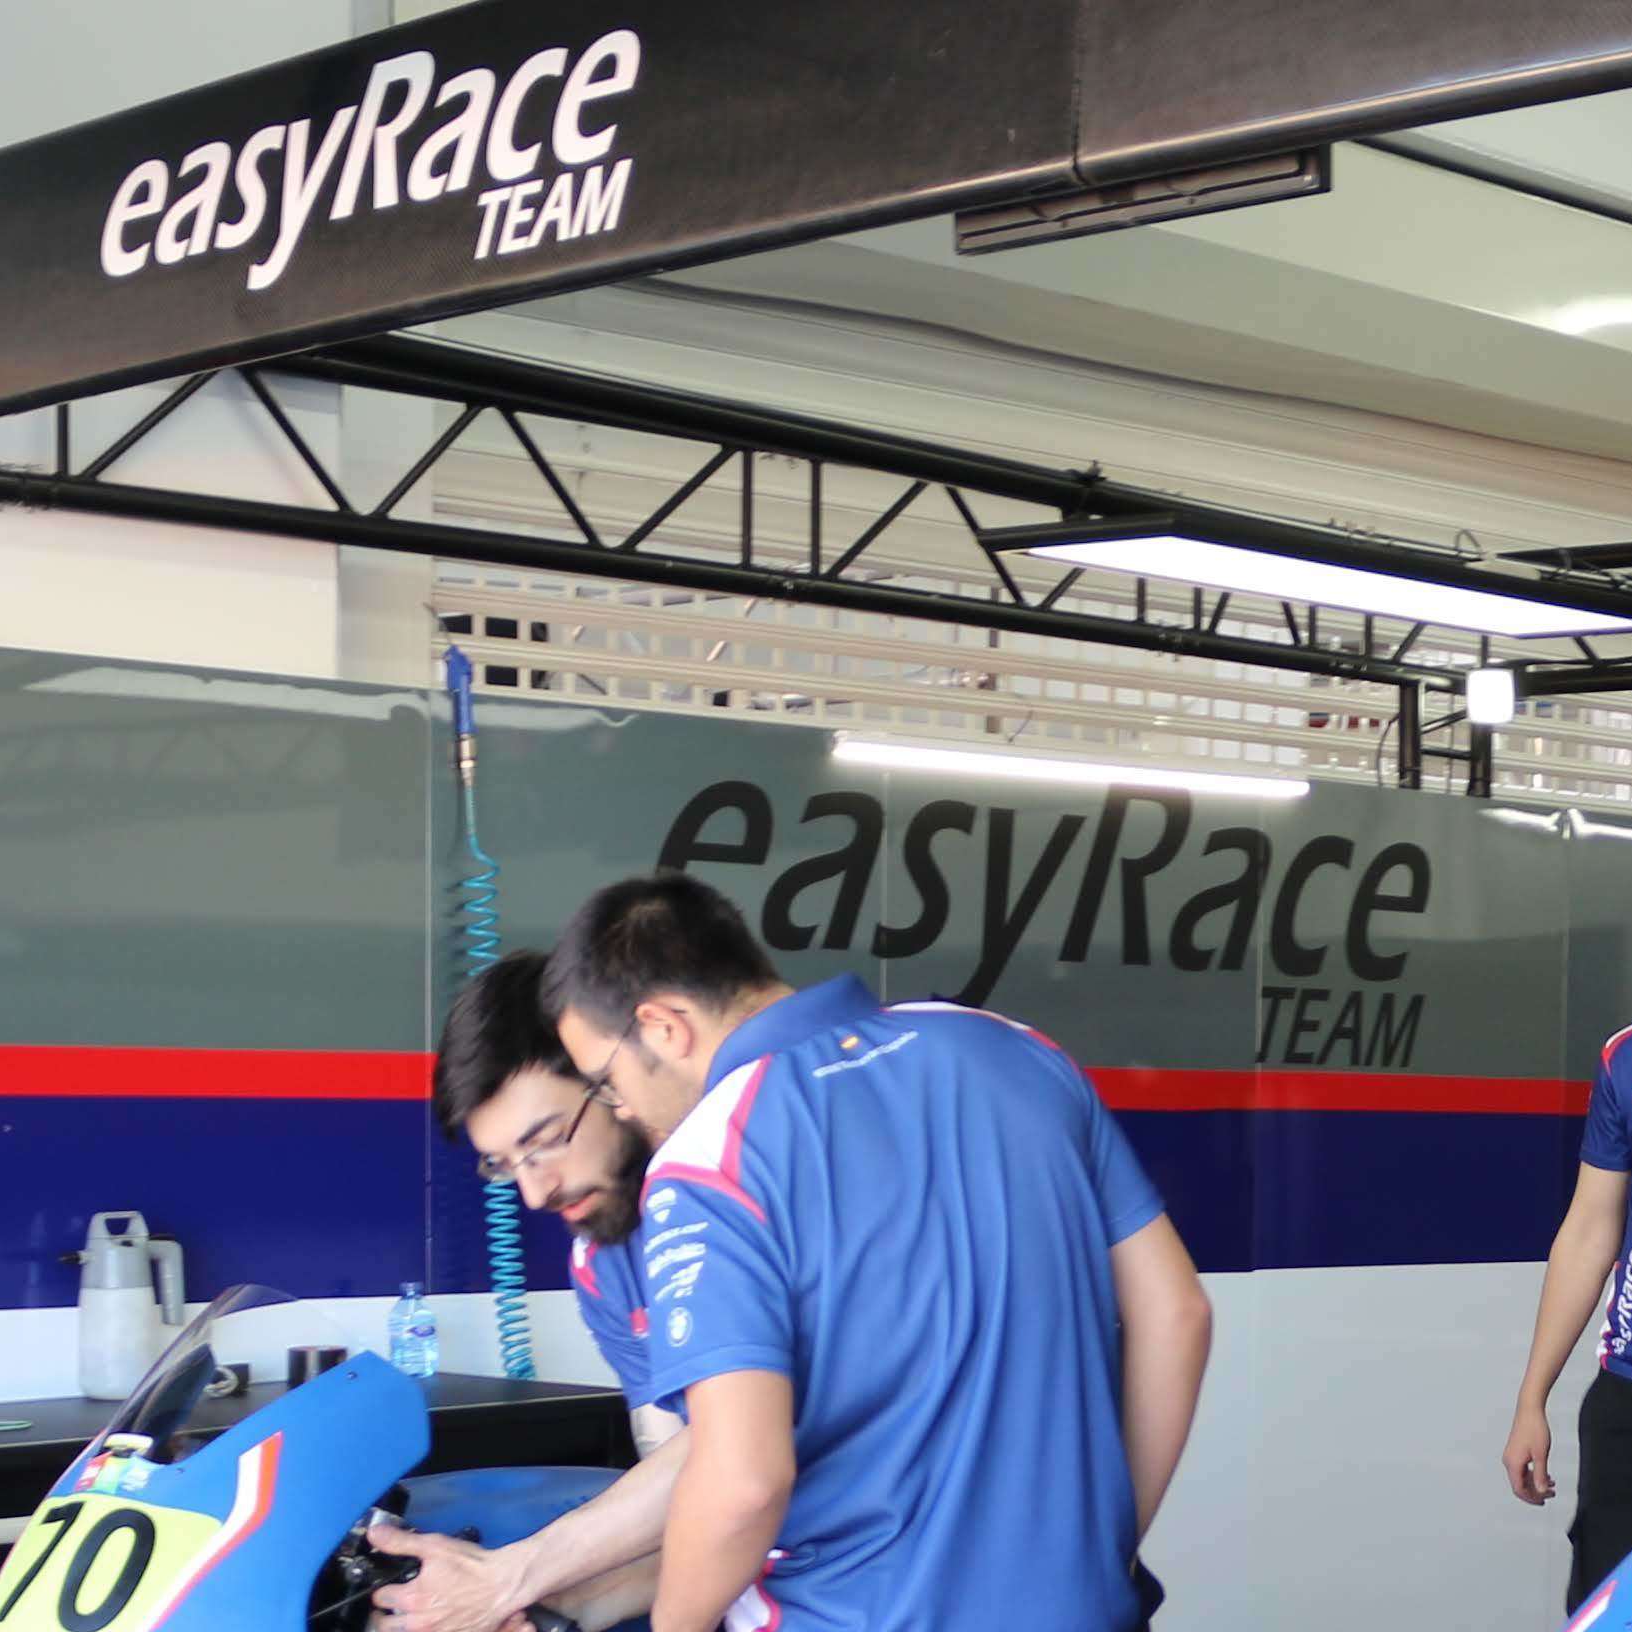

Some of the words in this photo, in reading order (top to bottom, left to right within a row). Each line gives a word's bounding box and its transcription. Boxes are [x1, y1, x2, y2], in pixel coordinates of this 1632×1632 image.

[100, 29, 641, 290] easyRace
[474, 158, 632, 260] TEAM
[655, 780, 1432, 1006] easyRace
[1256, 986, 1426, 1069] TEAM
